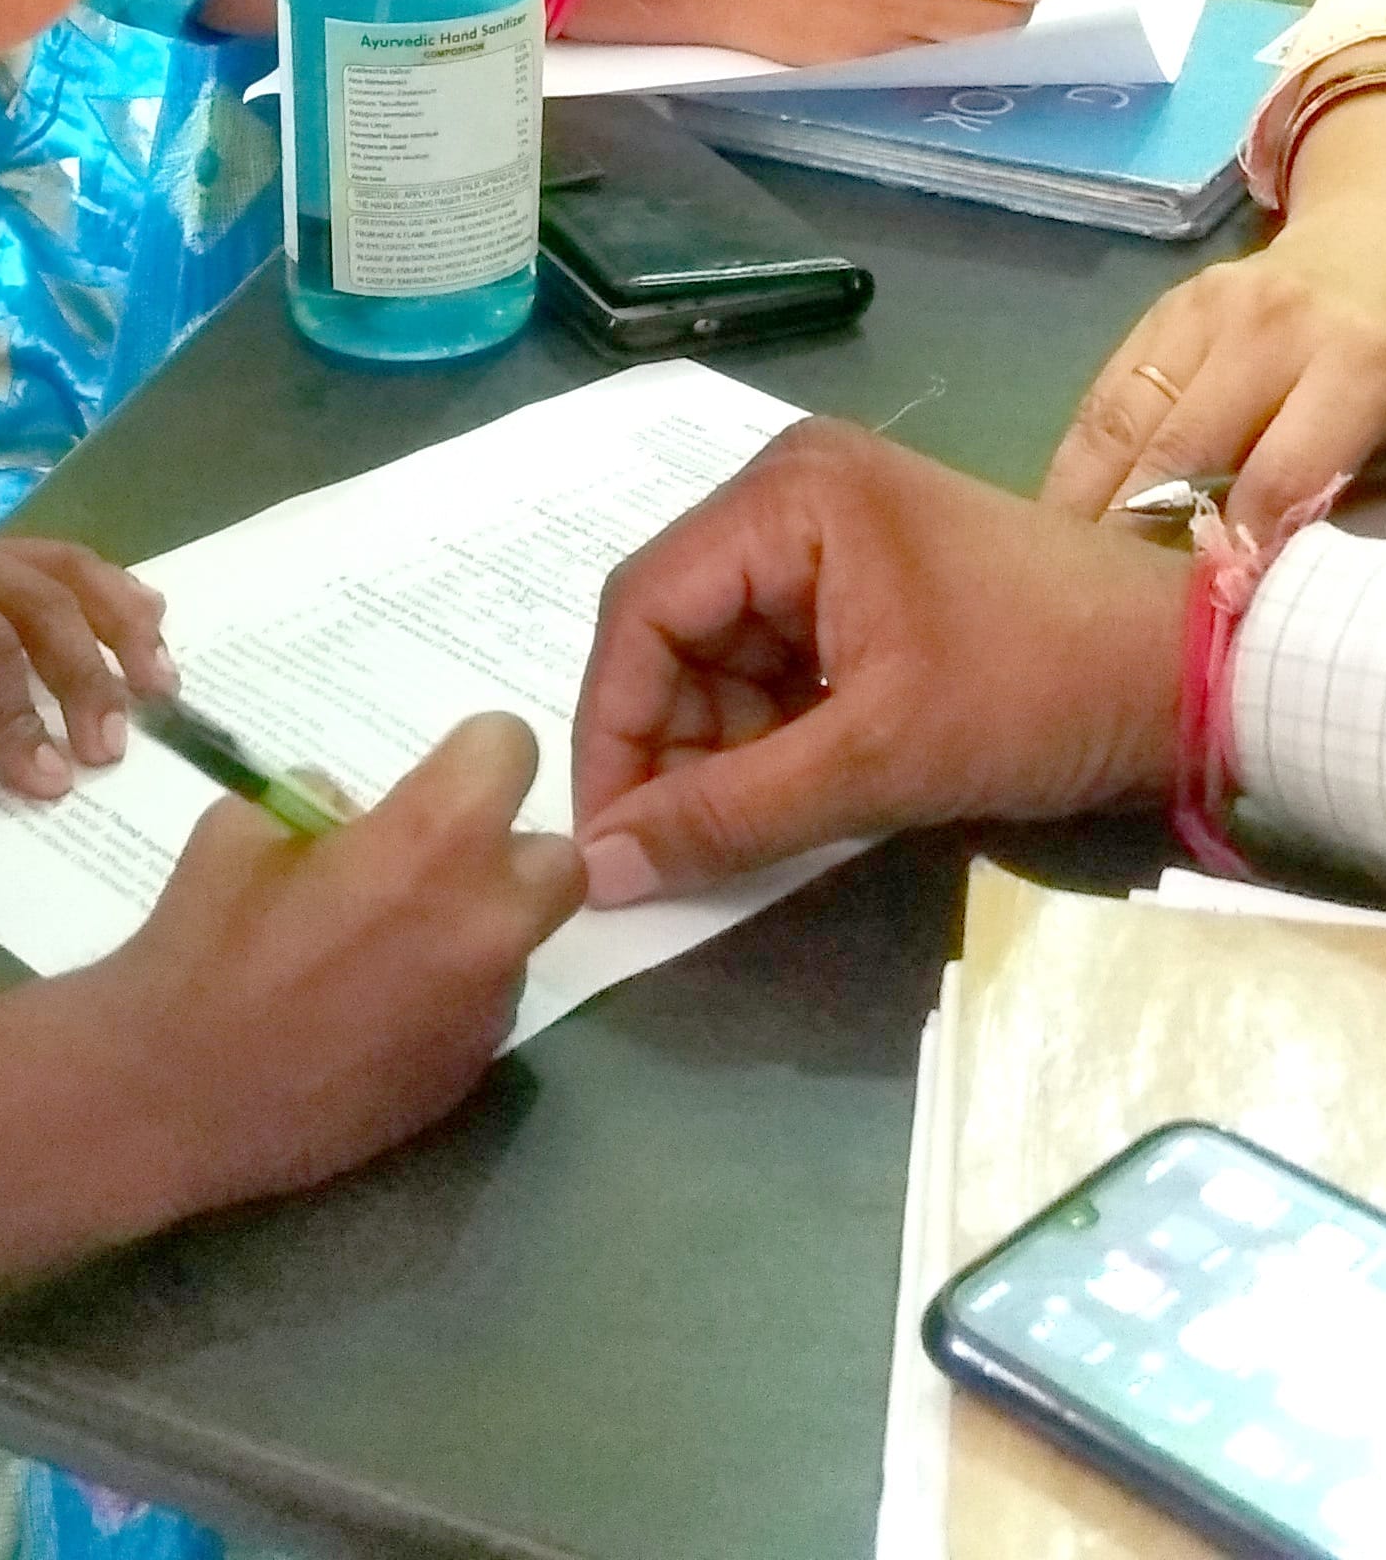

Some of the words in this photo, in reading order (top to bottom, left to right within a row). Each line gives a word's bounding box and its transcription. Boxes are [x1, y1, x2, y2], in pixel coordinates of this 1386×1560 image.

[361, 34, 434, 50] Ayurvedic
[440, 29, 477, 44] Hand
[482, 14, 528, 37] Sanitizer
[921, 84, 1035, 132] OK
